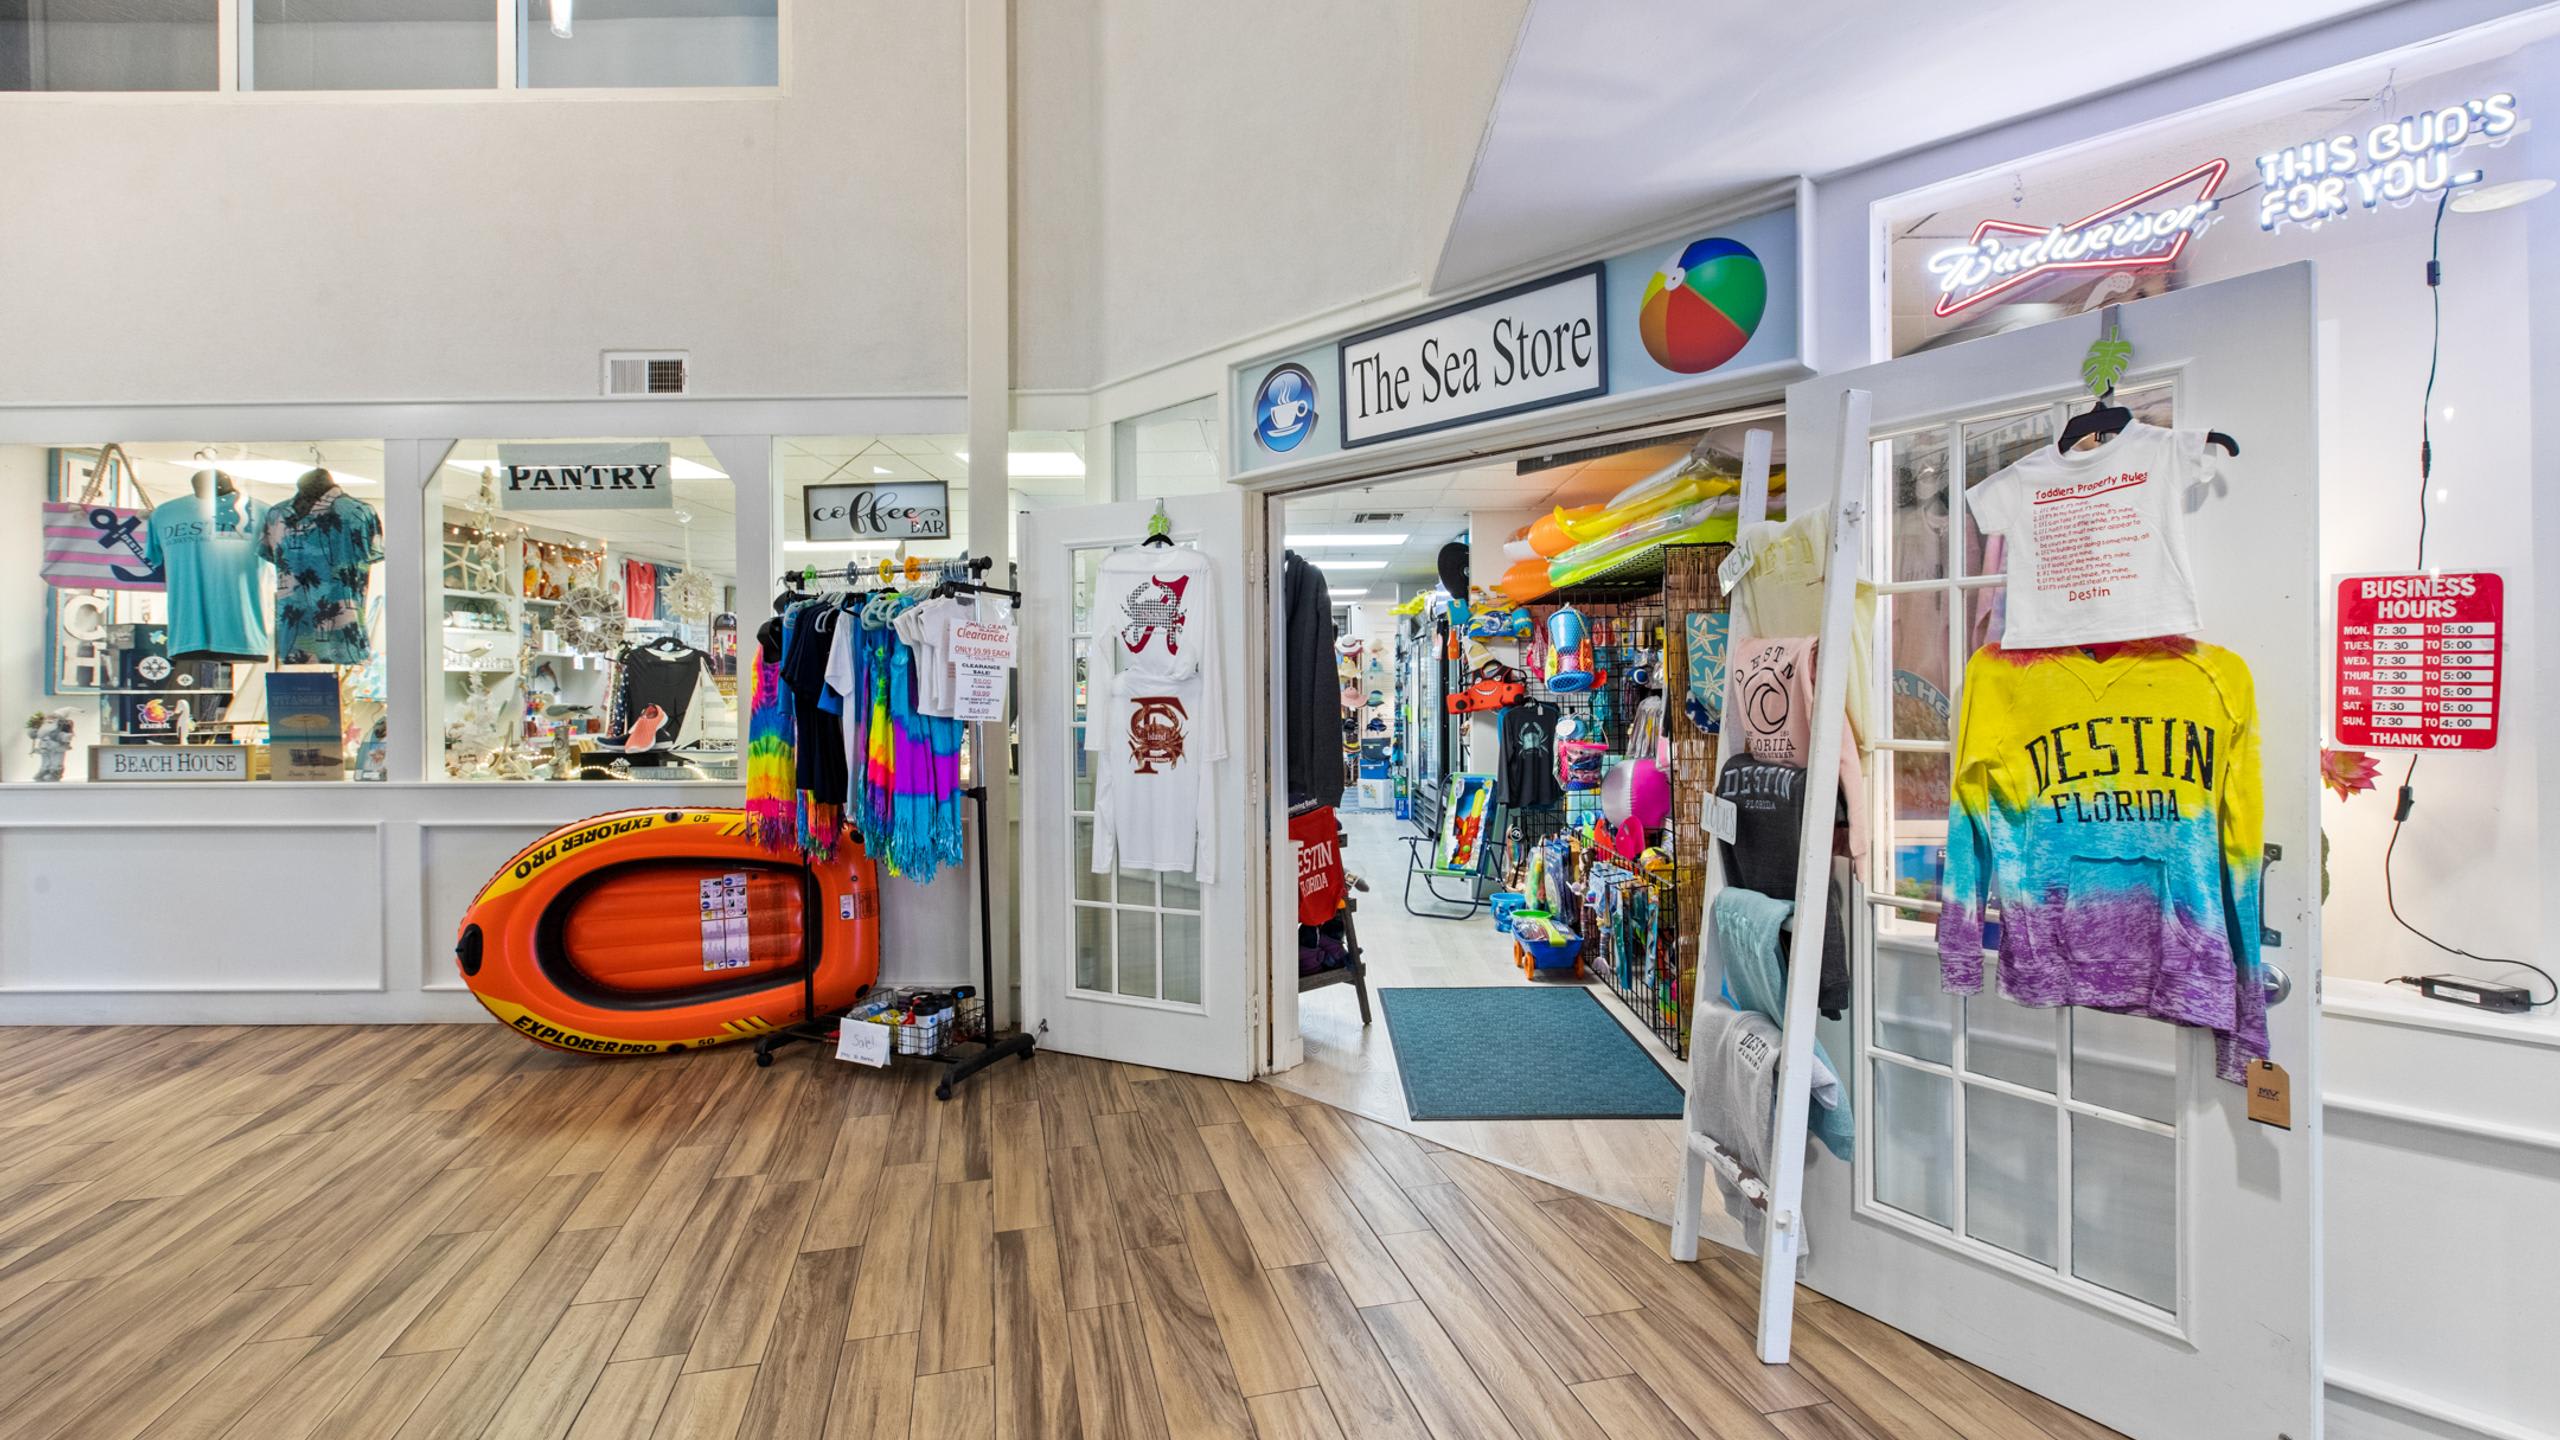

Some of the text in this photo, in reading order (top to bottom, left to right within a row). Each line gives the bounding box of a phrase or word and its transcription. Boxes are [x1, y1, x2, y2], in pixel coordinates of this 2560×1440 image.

[2256, 92, 2517, 191] THIS BUD'S
[2260, 181, 2348, 232] FOR
[1928, 198, 2219, 293] Budweiser
[1352, 316, 1593, 419] The Sea Store
[508, 464, 662, 491] PANTRY
[2034, 471, 2149, 500] Toddlers Property Rules
[813, 491, 941, 534] coffee
[910, 520, 944, 534] BAR
[1720, 539, 1751, 592] NEW
[2069, 587, 2111, 602] Destin
[2361, 577, 2476, 599] BUSINESS
[2378, 600, 2457, 619] HOURS
[957, 627, 1010, 643] Clearance!
[2343, 626, 2370, 635] MON.
[2426, 625, 2440, 634] TO
[992, 649, 1010, 657] EACH
[2343, 641, 2372, 650] TUES.
[2426, 640, 2440, 649] TO
[962, 662, 1001, 670] CLEARANCE
[2343, 657, 2370, 665] WED.
[2426, 656, 2440, 665] TO
[2343, 671, 2373, 680] THUR.
[2425, 671, 2439, 680] TO
[2342, 687, 2361, 695] FRI.
[2425, 687, 2439, 695] TO
[2342, 702, 2364, 710] SAT.
[2424, 702, 2438, 711] TO
[2342, 717, 2366, 725] SUN.
[2424, 717, 2438, 727] TO
[2370, 732, 2462, 747] THANK YOU
[114, 753, 236, 773] BEACH HOUSE
[2024, 715, 2215, 796] DESTIN
[1722, 766, 1796, 800] DESTIN
[1744, 799, 1776, 810] FLORIDA
[2050, 789, 2181, 823] FLORIDA
[693, 814, 711, 823] 50
[515, 816, 654, 879] EXPLORER PRO
[512, 1015, 657, 1054] EXPLORER PRO
[698, 1037, 715, 1047] 50
